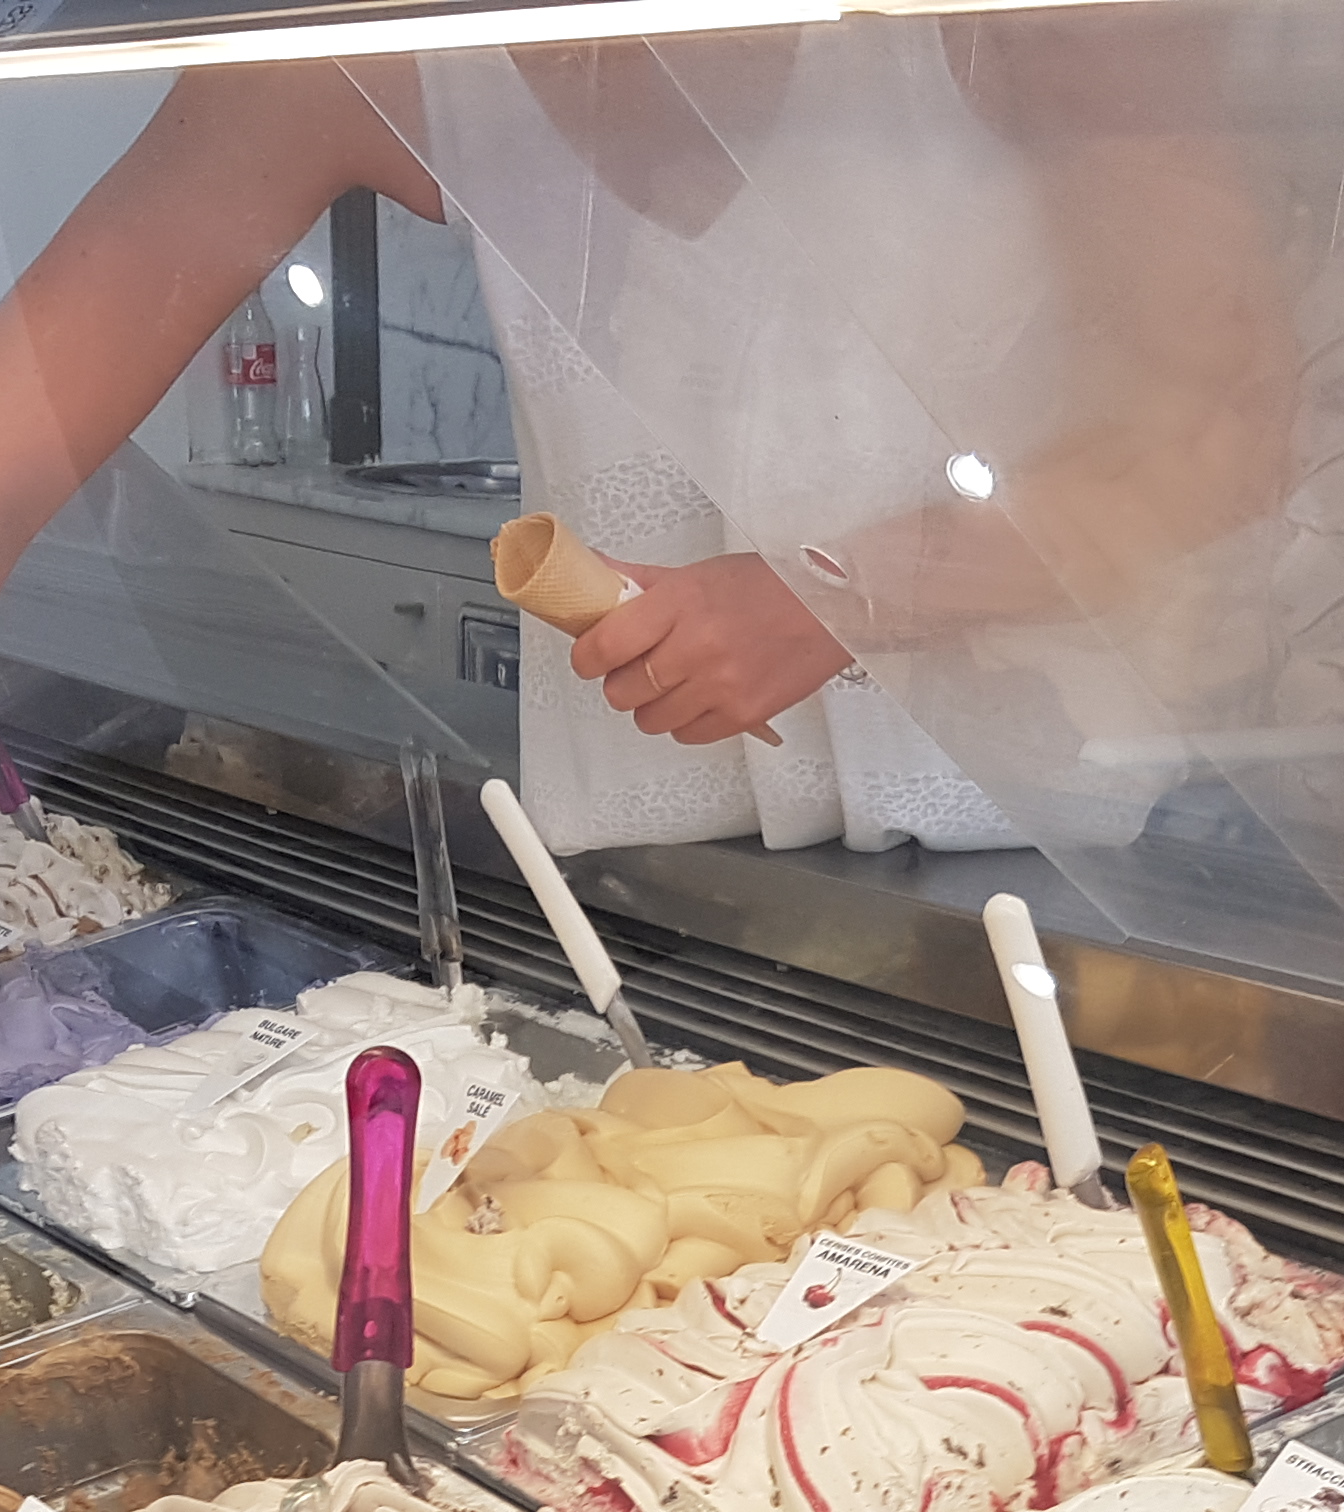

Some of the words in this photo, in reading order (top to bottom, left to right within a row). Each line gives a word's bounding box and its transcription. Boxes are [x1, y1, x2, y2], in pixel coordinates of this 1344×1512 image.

[257, 1019, 302, 1040] BULGARE
[249, 1031, 286, 1049] NATURE
[466, 1084, 506, 1107] CARAMEL
[466, 1101, 491, 1118] SALÉ
[818, 1238, 863, 1255] CERISES
[816, 1249, 891, 1279] AMARENA
